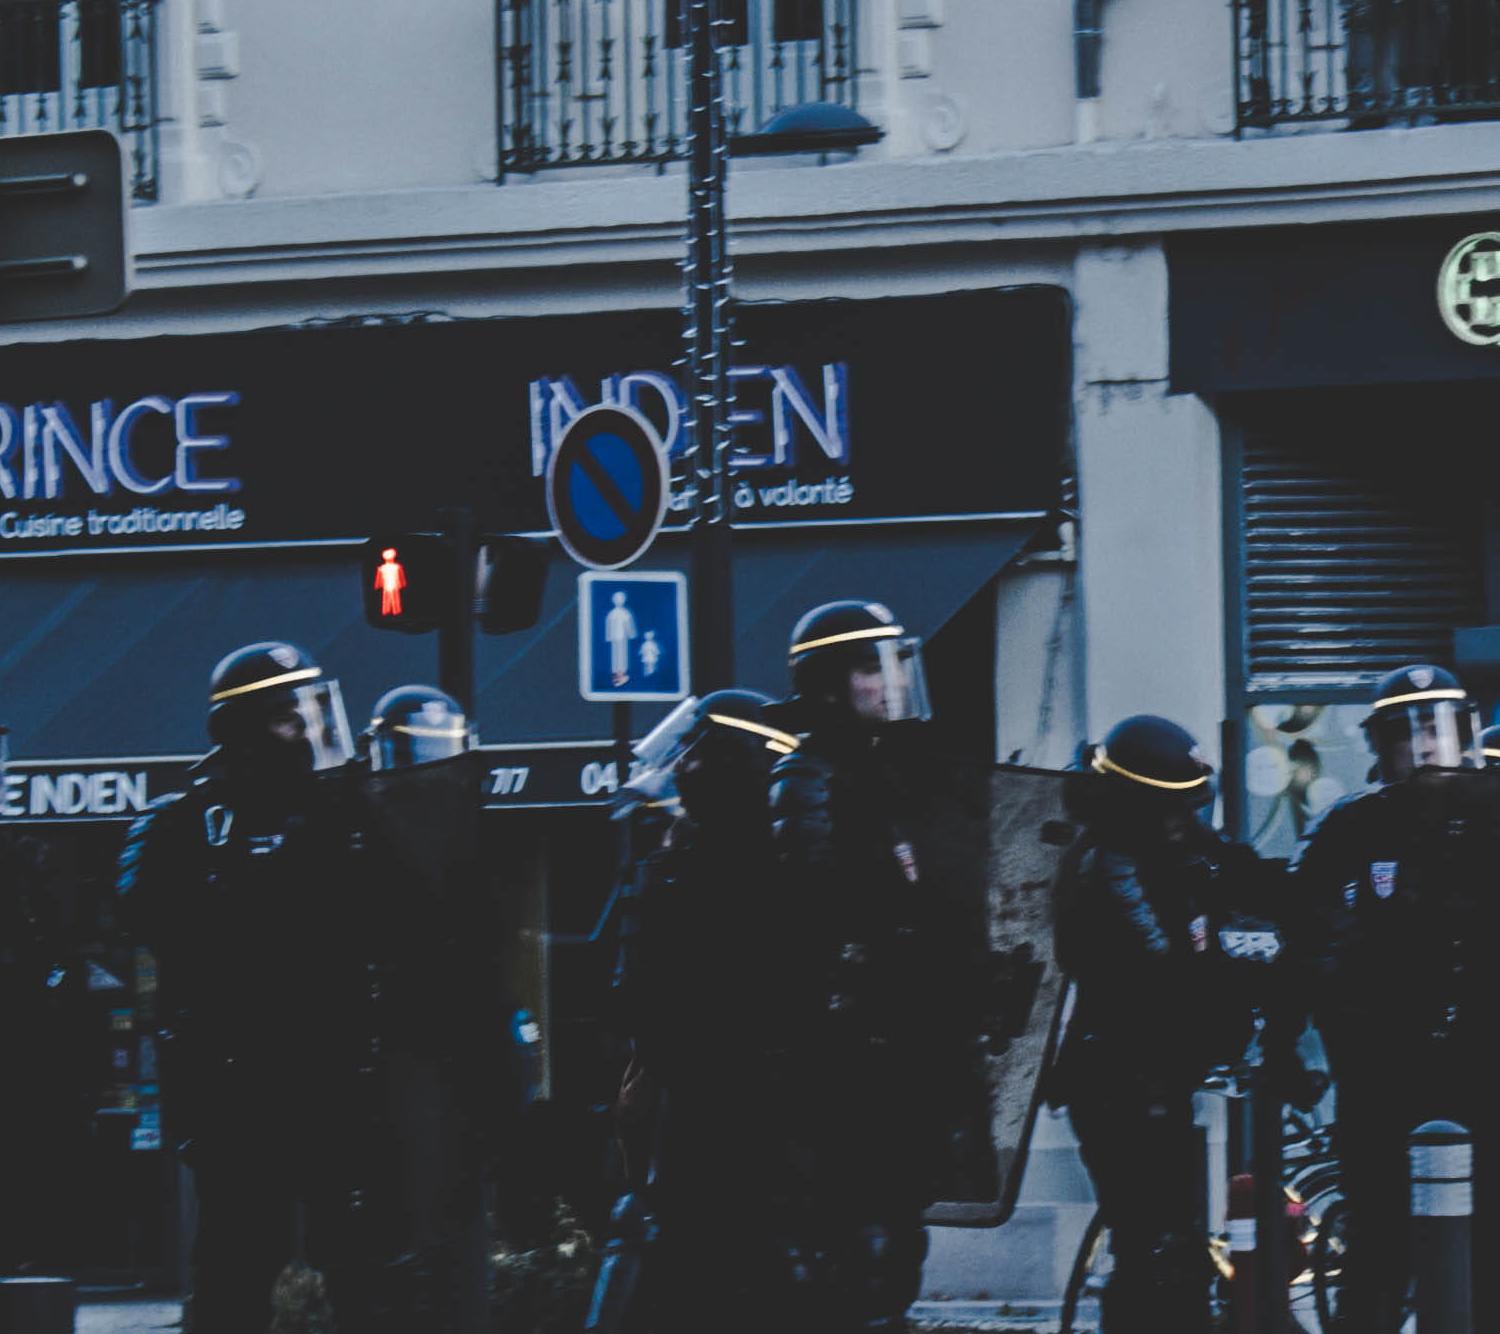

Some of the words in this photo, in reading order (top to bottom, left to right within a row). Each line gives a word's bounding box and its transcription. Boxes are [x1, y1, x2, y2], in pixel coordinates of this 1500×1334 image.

[529, 363, 849, 478] INDEN
[733, 480, 756, 508] à
[757, 476, 855, 507] volonté
[87, 503, 247, 535] traditionnelle
[29, 770, 149, 816] INDIEN
[581, 760, 620, 796] 04
